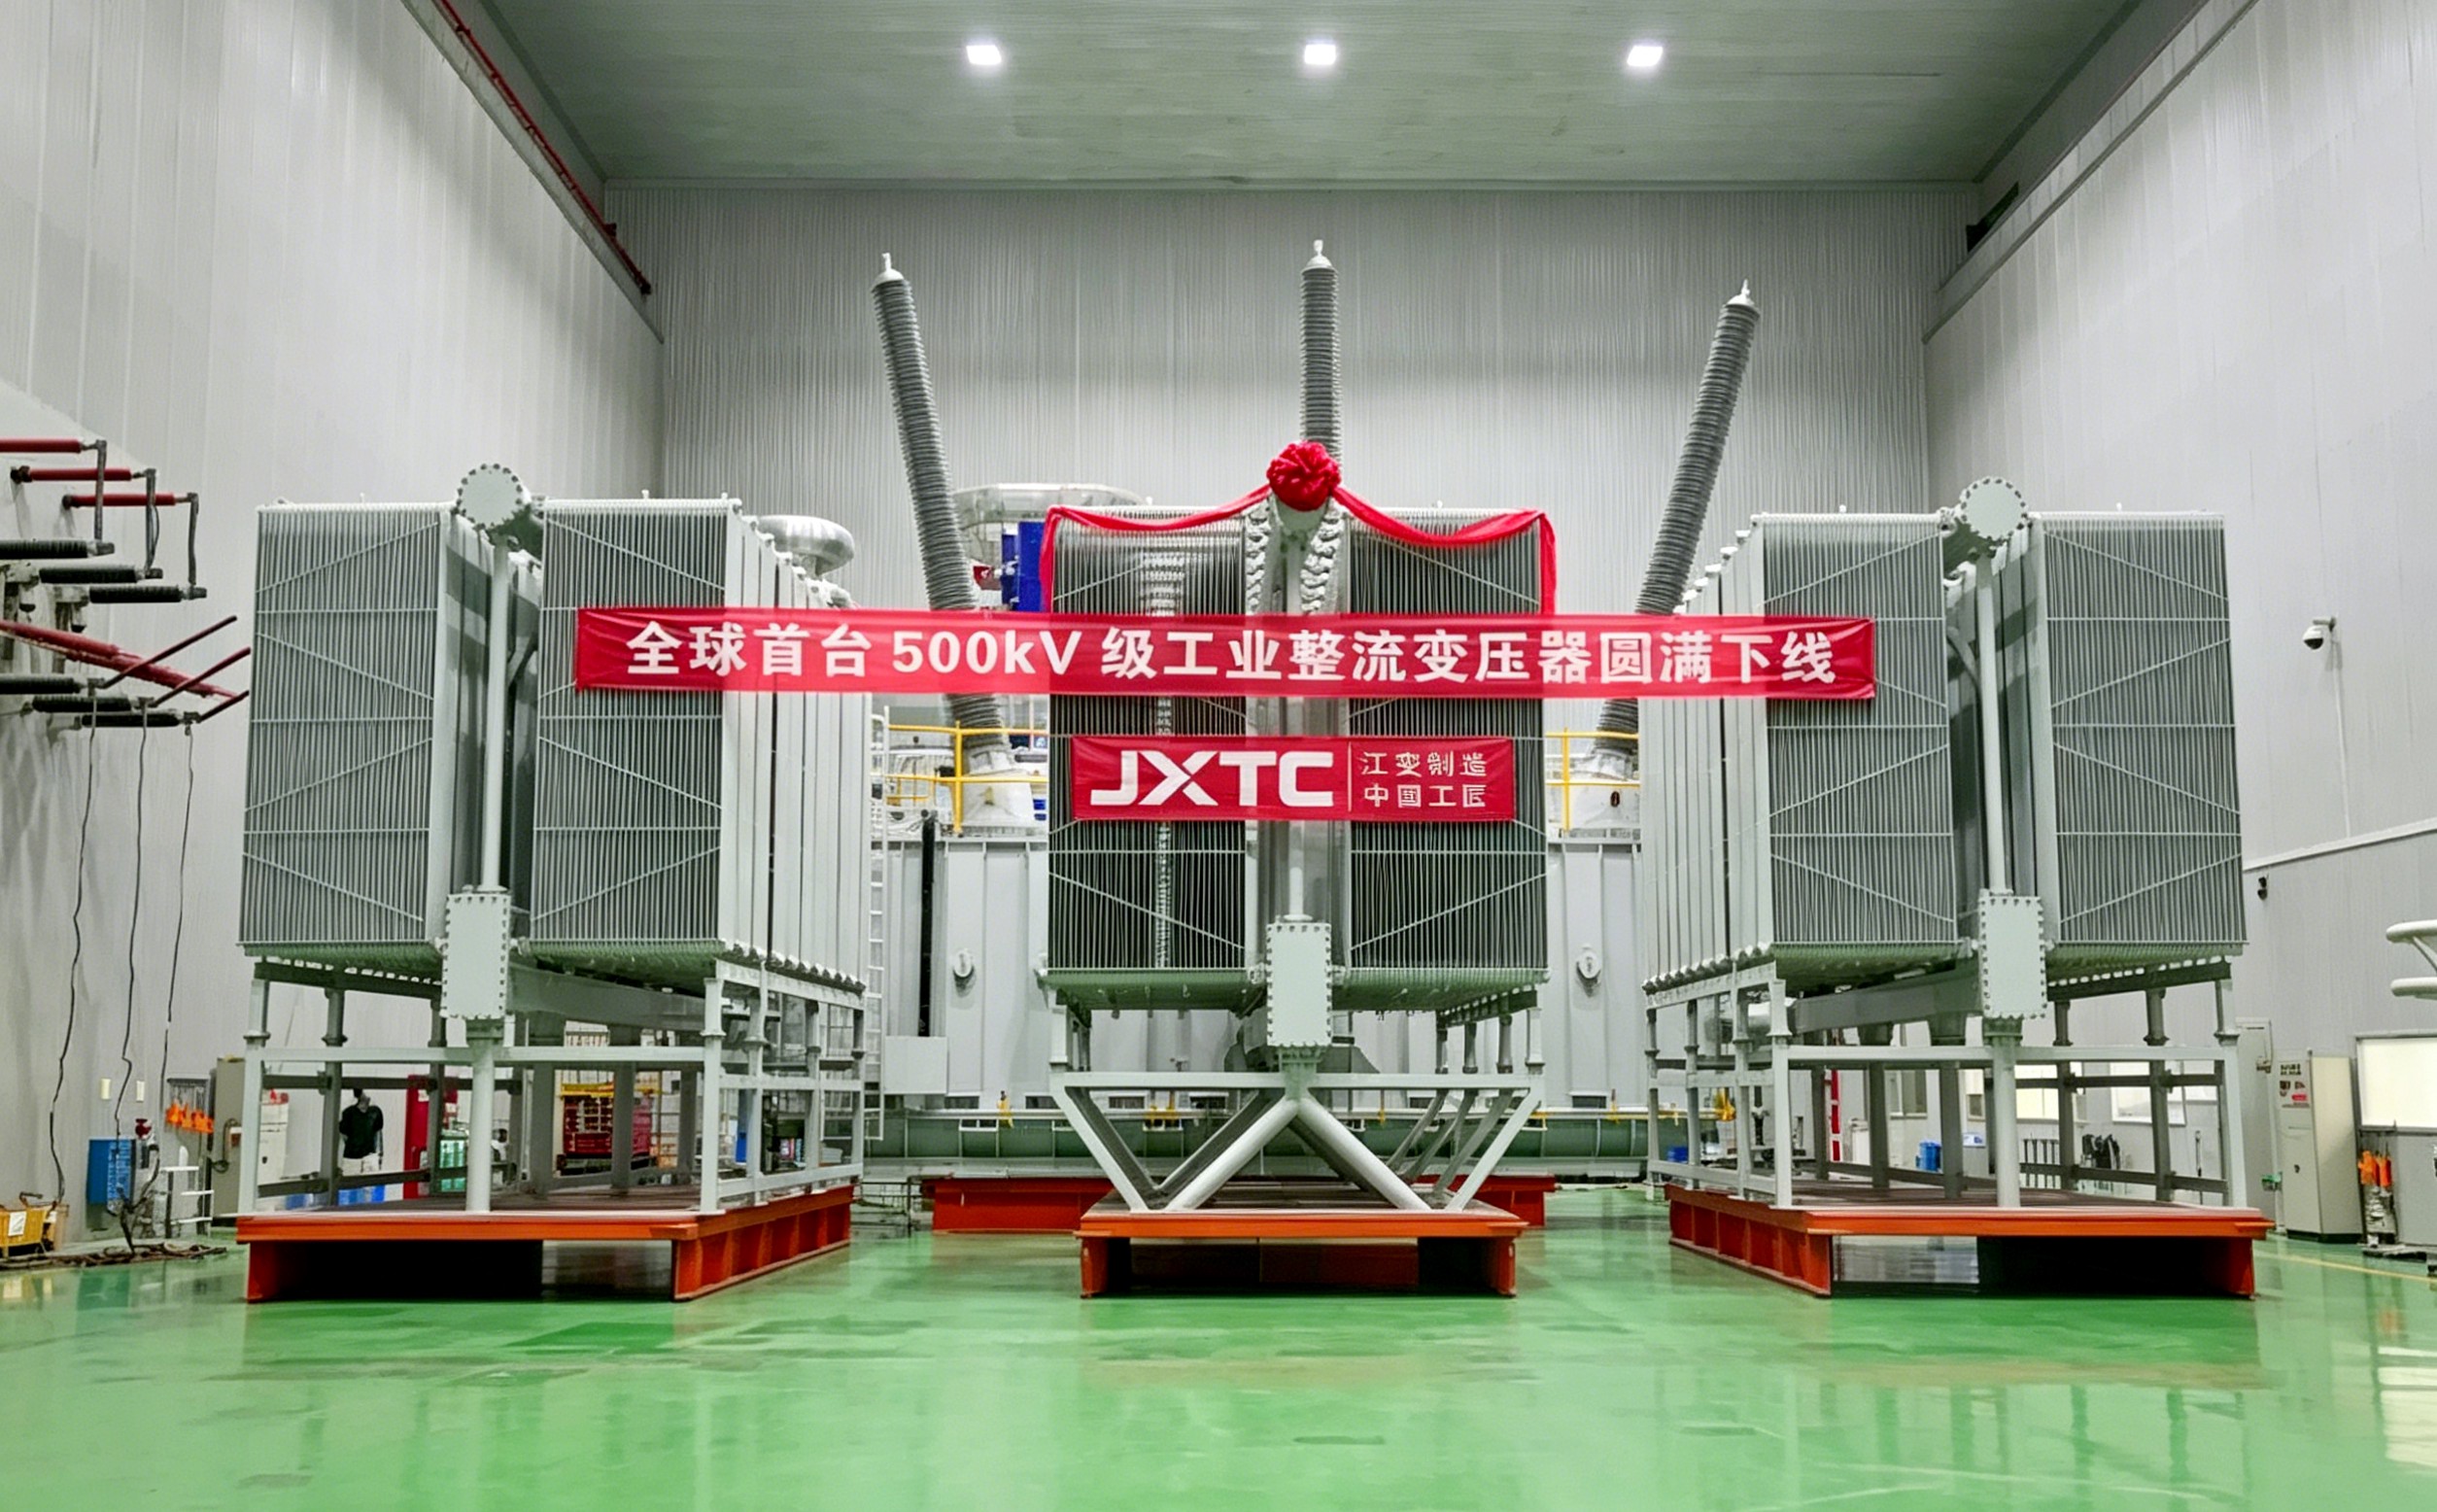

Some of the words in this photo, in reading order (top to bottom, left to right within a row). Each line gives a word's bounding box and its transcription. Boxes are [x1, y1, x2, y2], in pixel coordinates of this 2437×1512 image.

[627, 621, 872, 677] 全球首台
[892, 630, 1081, 675] 500kV
[1101, 627, 1836, 684] 级工业整流变压器圆满下线
[1089, 750, 1334, 808] JXTC
